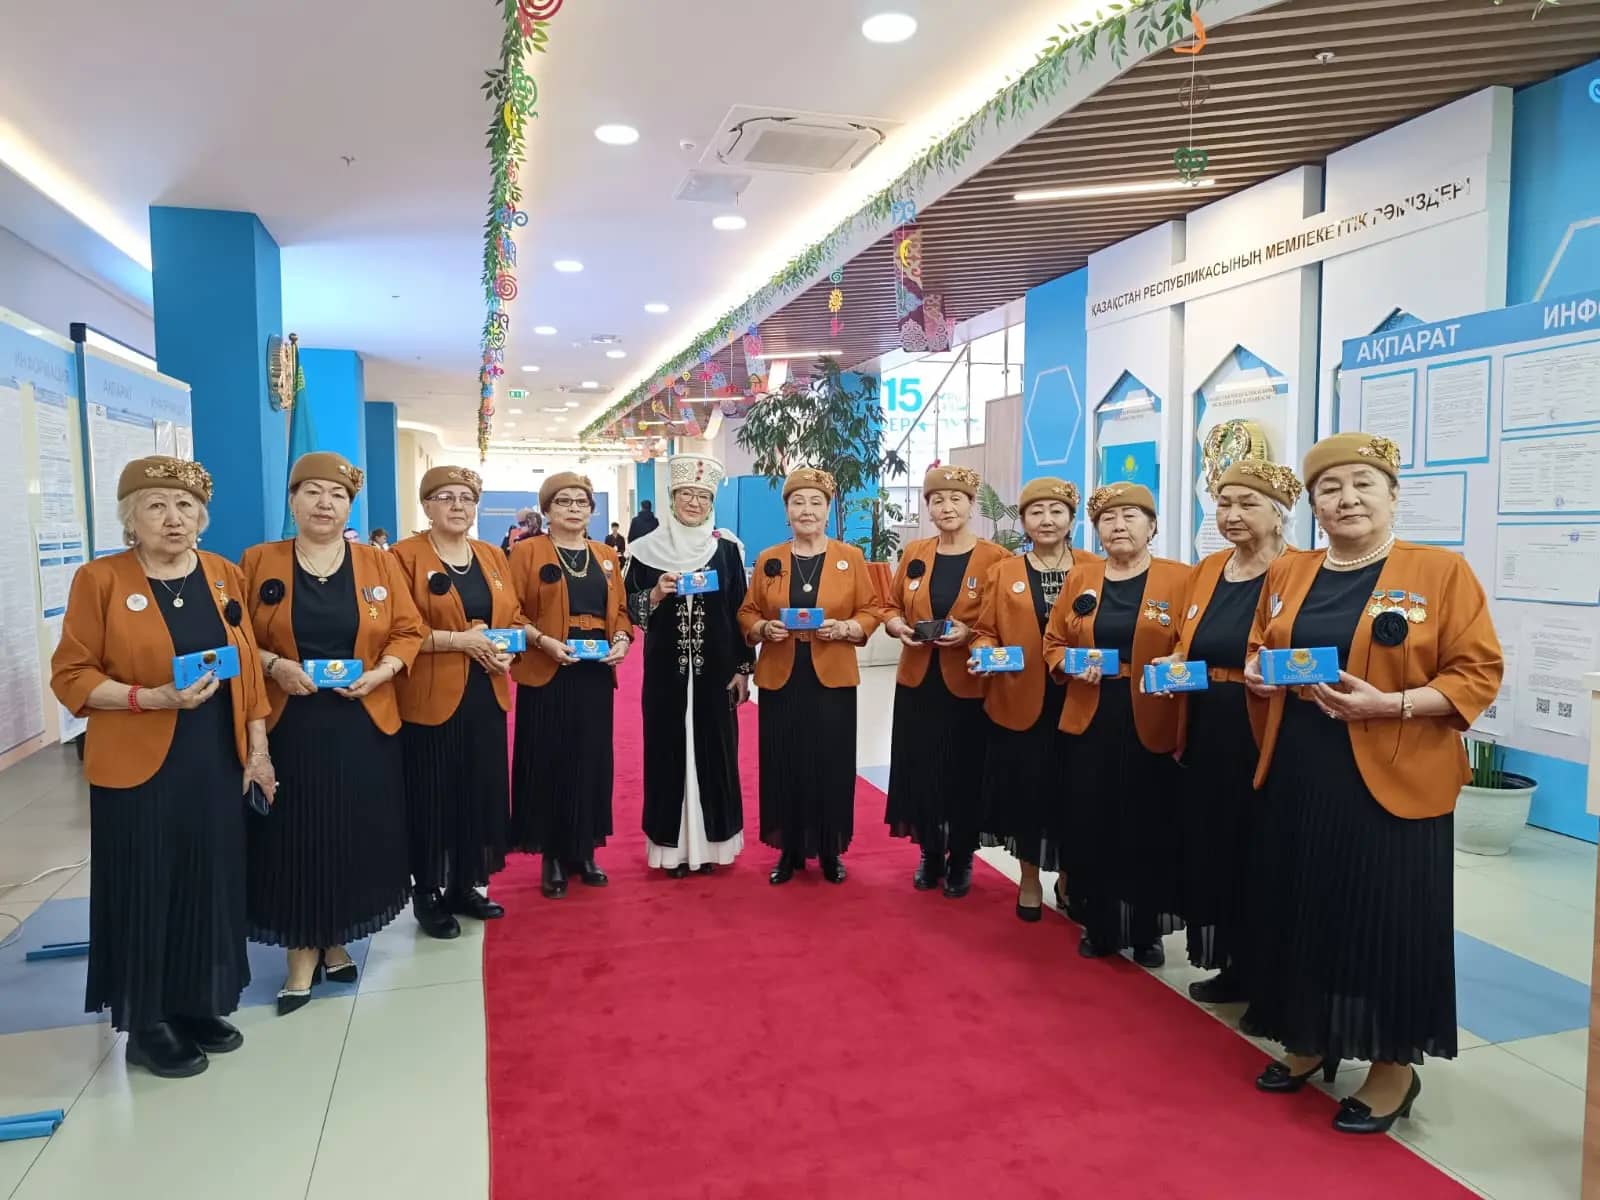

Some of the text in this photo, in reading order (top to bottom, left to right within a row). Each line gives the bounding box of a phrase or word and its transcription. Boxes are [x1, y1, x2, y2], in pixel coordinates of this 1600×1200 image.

[1091, 289, 1142, 317] ҚАЗАҚСТАН
[1143, 250, 1263, 300] РЕСПУБЛИКАСЫНЫҢ
[1265, 212, 1368, 262] МЕМЛЕКЕТТІК
[1356, 298, 1600, 363] АҚПАРАТ ИНФ
[882, 377, 923, 412] 15
